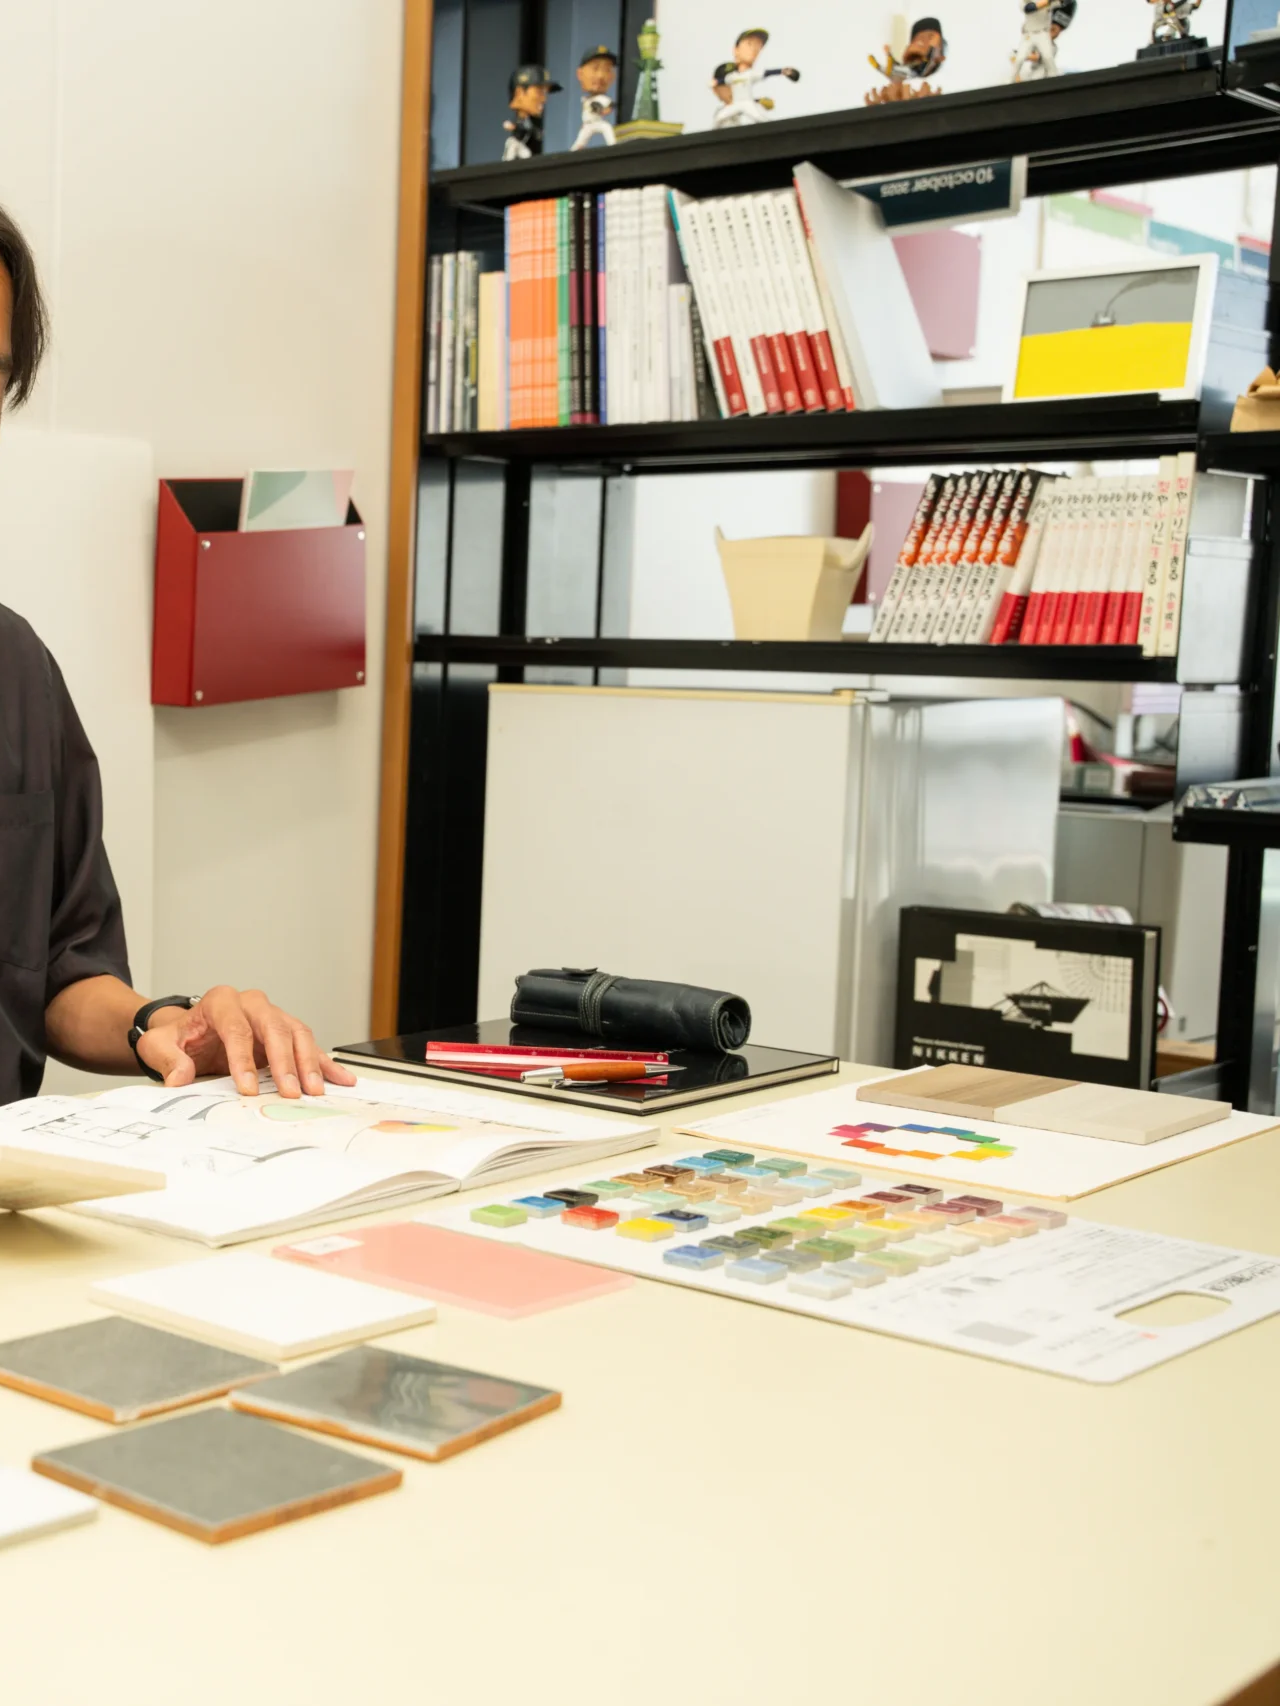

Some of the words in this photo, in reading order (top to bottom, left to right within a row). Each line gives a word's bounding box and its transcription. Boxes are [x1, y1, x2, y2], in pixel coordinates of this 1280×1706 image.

[912, 169, 974, 192] october
[975, 167, 995, 184] 10
[912, 1045, 985, 1066] NIKKEN
